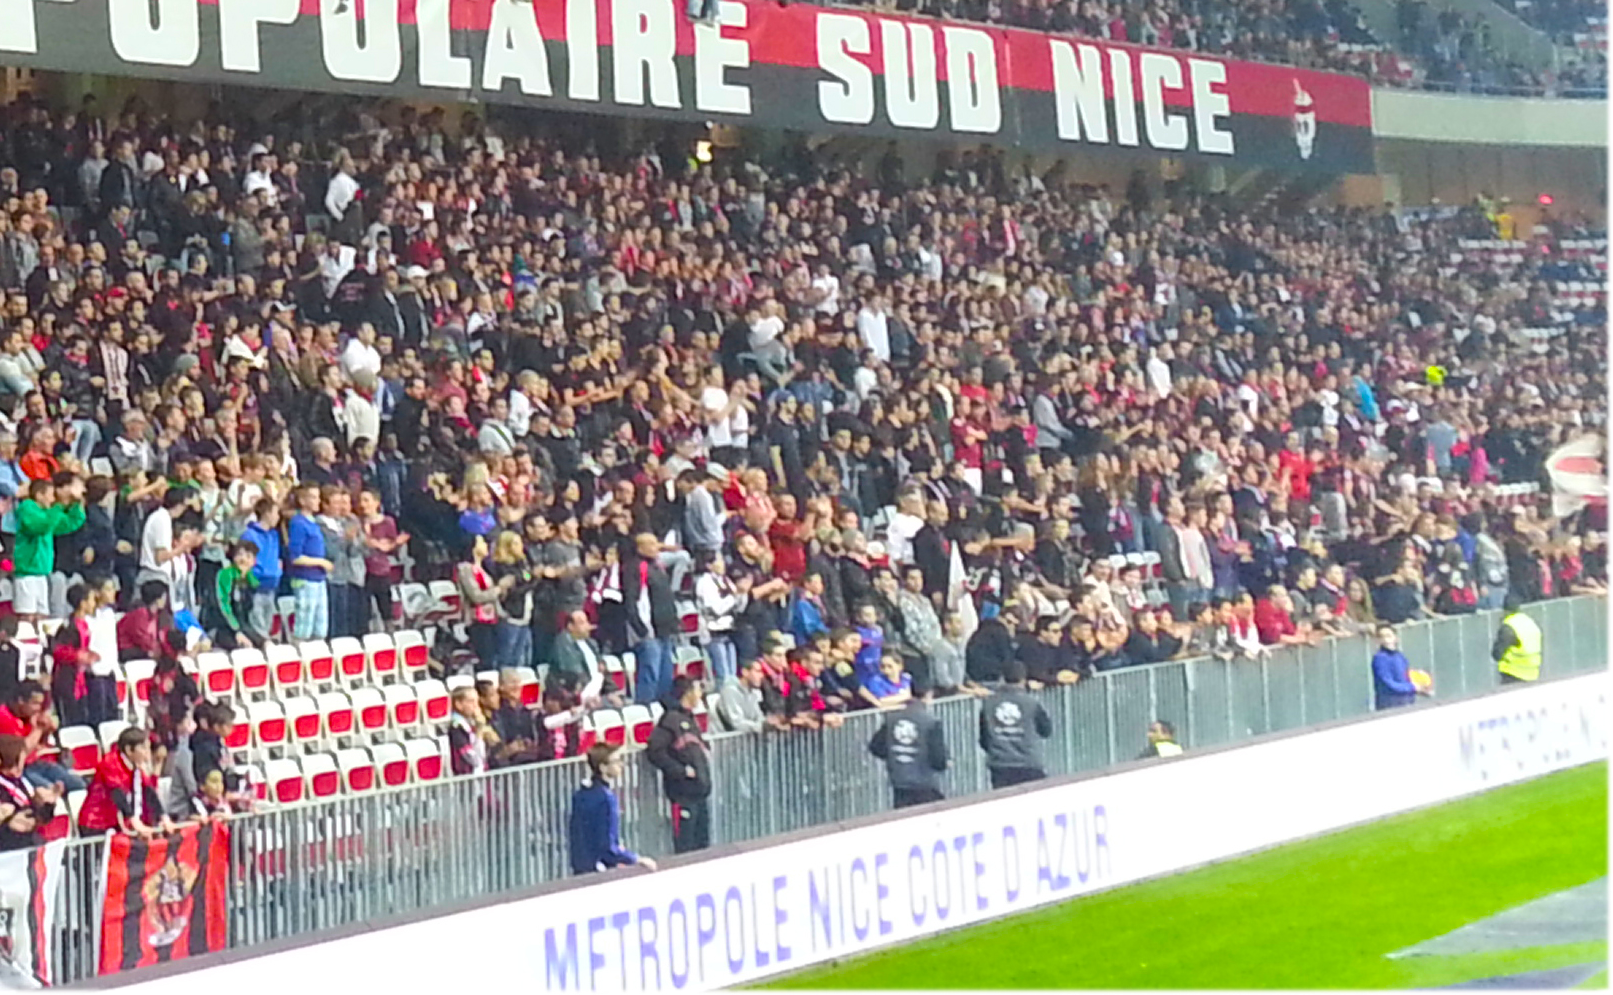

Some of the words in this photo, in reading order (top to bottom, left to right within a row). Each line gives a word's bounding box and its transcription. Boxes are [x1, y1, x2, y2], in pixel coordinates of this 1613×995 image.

[816, 11, 1002, 135] SUD
[1049, 37, 1234, 155] NICE
[808, 850, 894, 953] NICE
